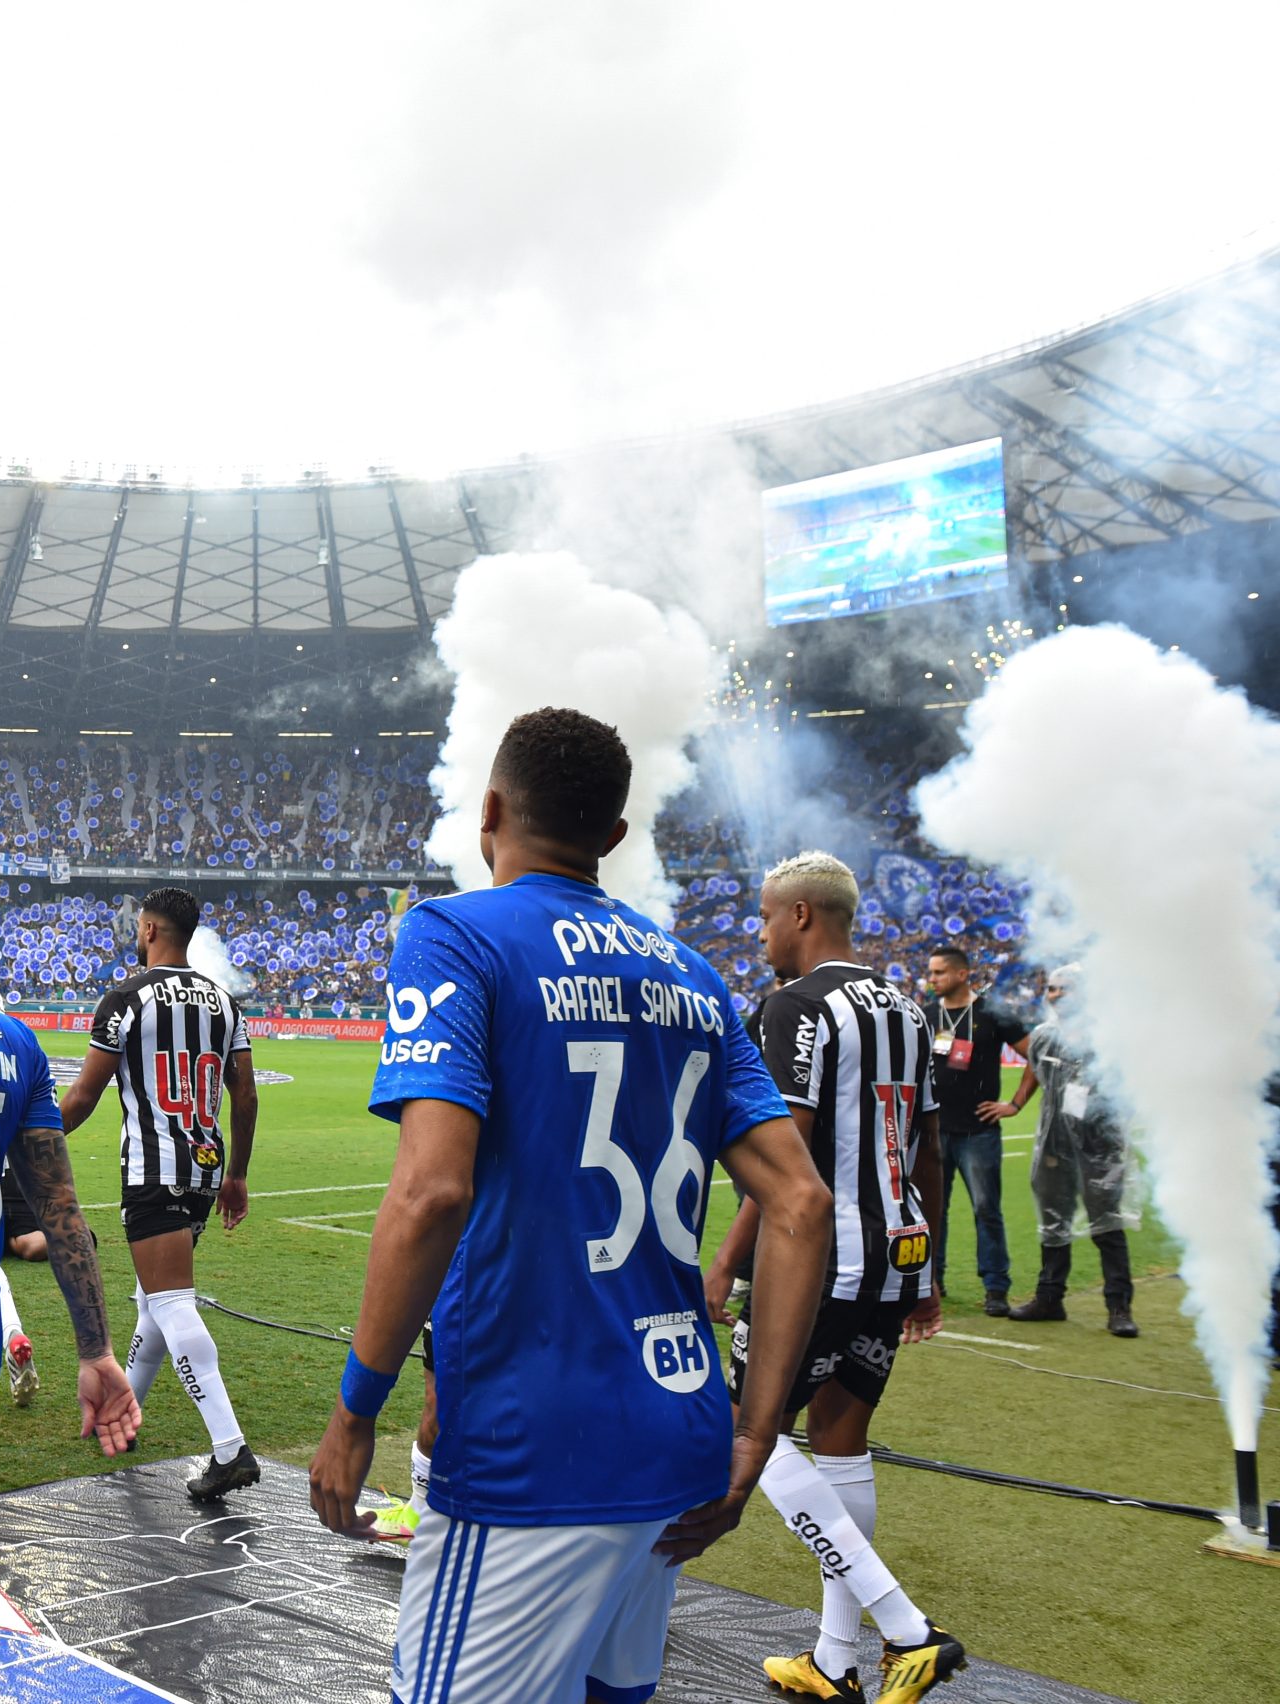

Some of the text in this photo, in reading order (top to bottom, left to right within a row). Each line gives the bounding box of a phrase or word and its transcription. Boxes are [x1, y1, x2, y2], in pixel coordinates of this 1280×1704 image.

[552, 912, 689, 973] pixbet
[173, 985, 220, 1014] bmg
[193, 981, 211, 989] GALO
[538, 976, 725, 1037] RAFAEL SANTOS
[280, 1023, 303, 1035] JOGO
[342, 1025, 379, 1037] AGORA!
[379, 1036, 452, 1066] user
[794, 1013, 817, 1064] MRV
[154, 1050, 222, 1131] 40
[566, 1040, 711, 1274] 36
[870, 1082, 919, 1205] 11
[885, 1117, 898, 1167] SOLATIO
[896, 1236, 927, 1267] BH
[177, 1355, 207, 1404] TODOS
[652, 1332, 705, 1379] BH
[790, 1511, 852, 1578] TODOS
